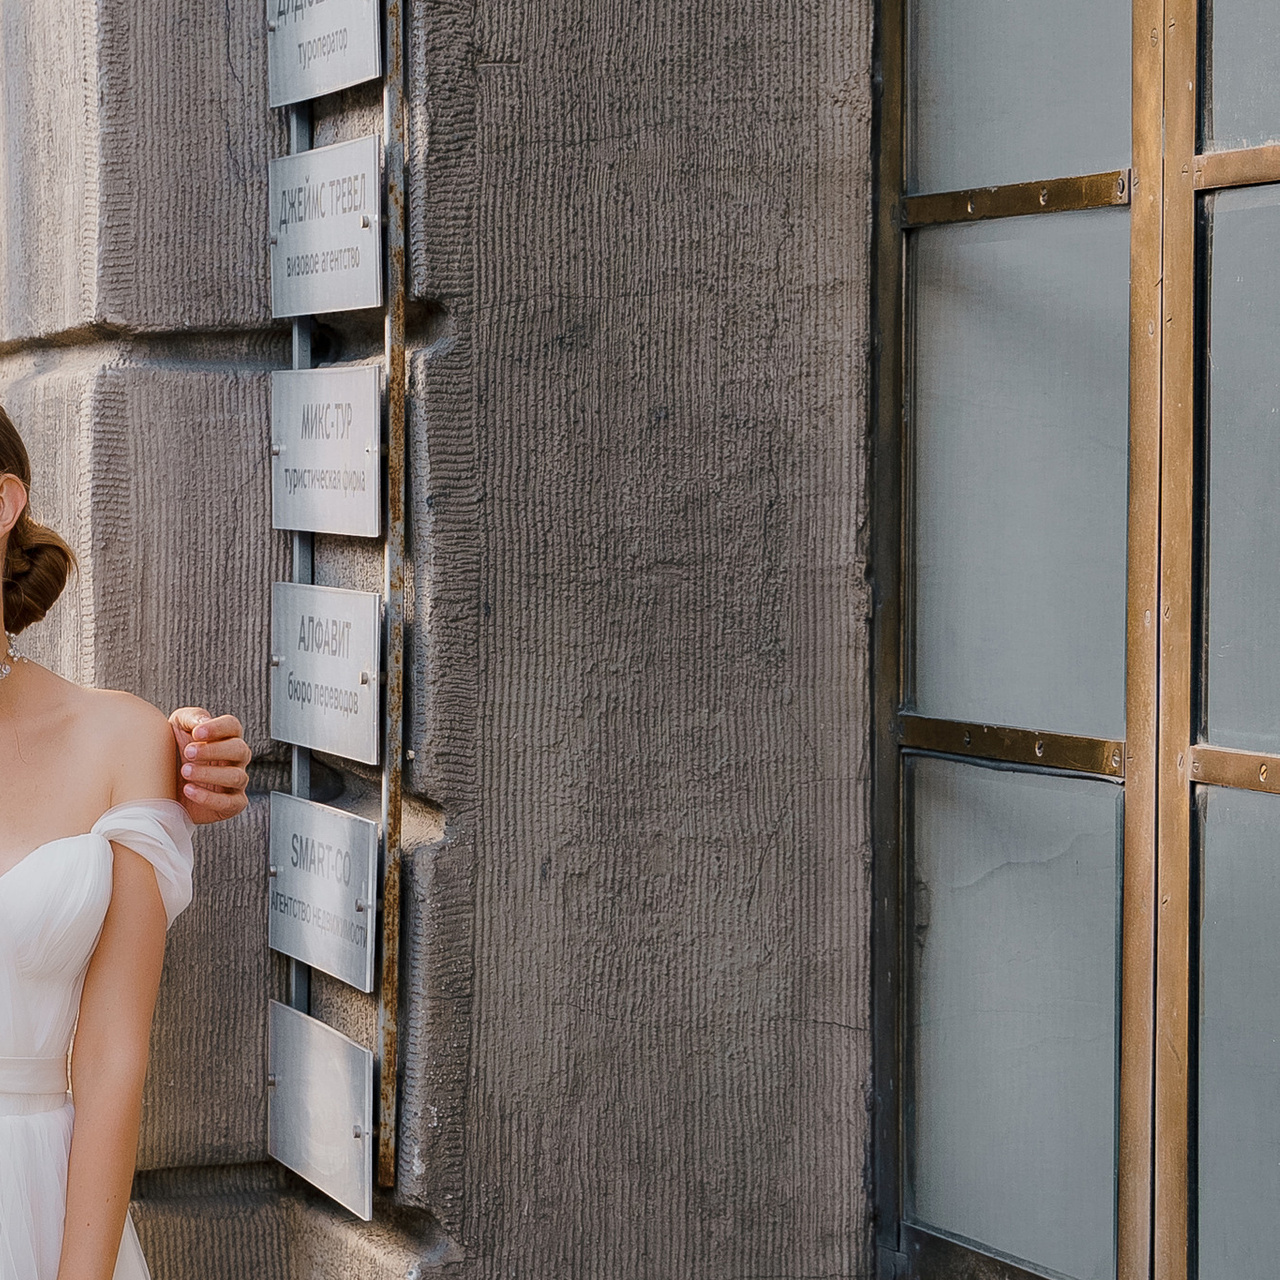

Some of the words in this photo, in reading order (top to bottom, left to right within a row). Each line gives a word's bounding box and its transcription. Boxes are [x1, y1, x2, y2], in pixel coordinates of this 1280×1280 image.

[297, 27, 348, 70] туроператор
[279, 175, 326, 235] ДЖЕЙМС
[329, 172, 366, 217] ТРЕВЕЛ
[286, 251, 320, 278] визовое
[321, 246, 361, 274] агентство
[284, 468, 341, 496] туристическая
[342, 463, 366, 497] фирма
[298, 615, 353, 659] АЛФАВИТ
[287, 671, 312, 710] бюро
[313, 684, 359, 718] переводов
[271, 891, 312, 924] АГЕНТСТВО
